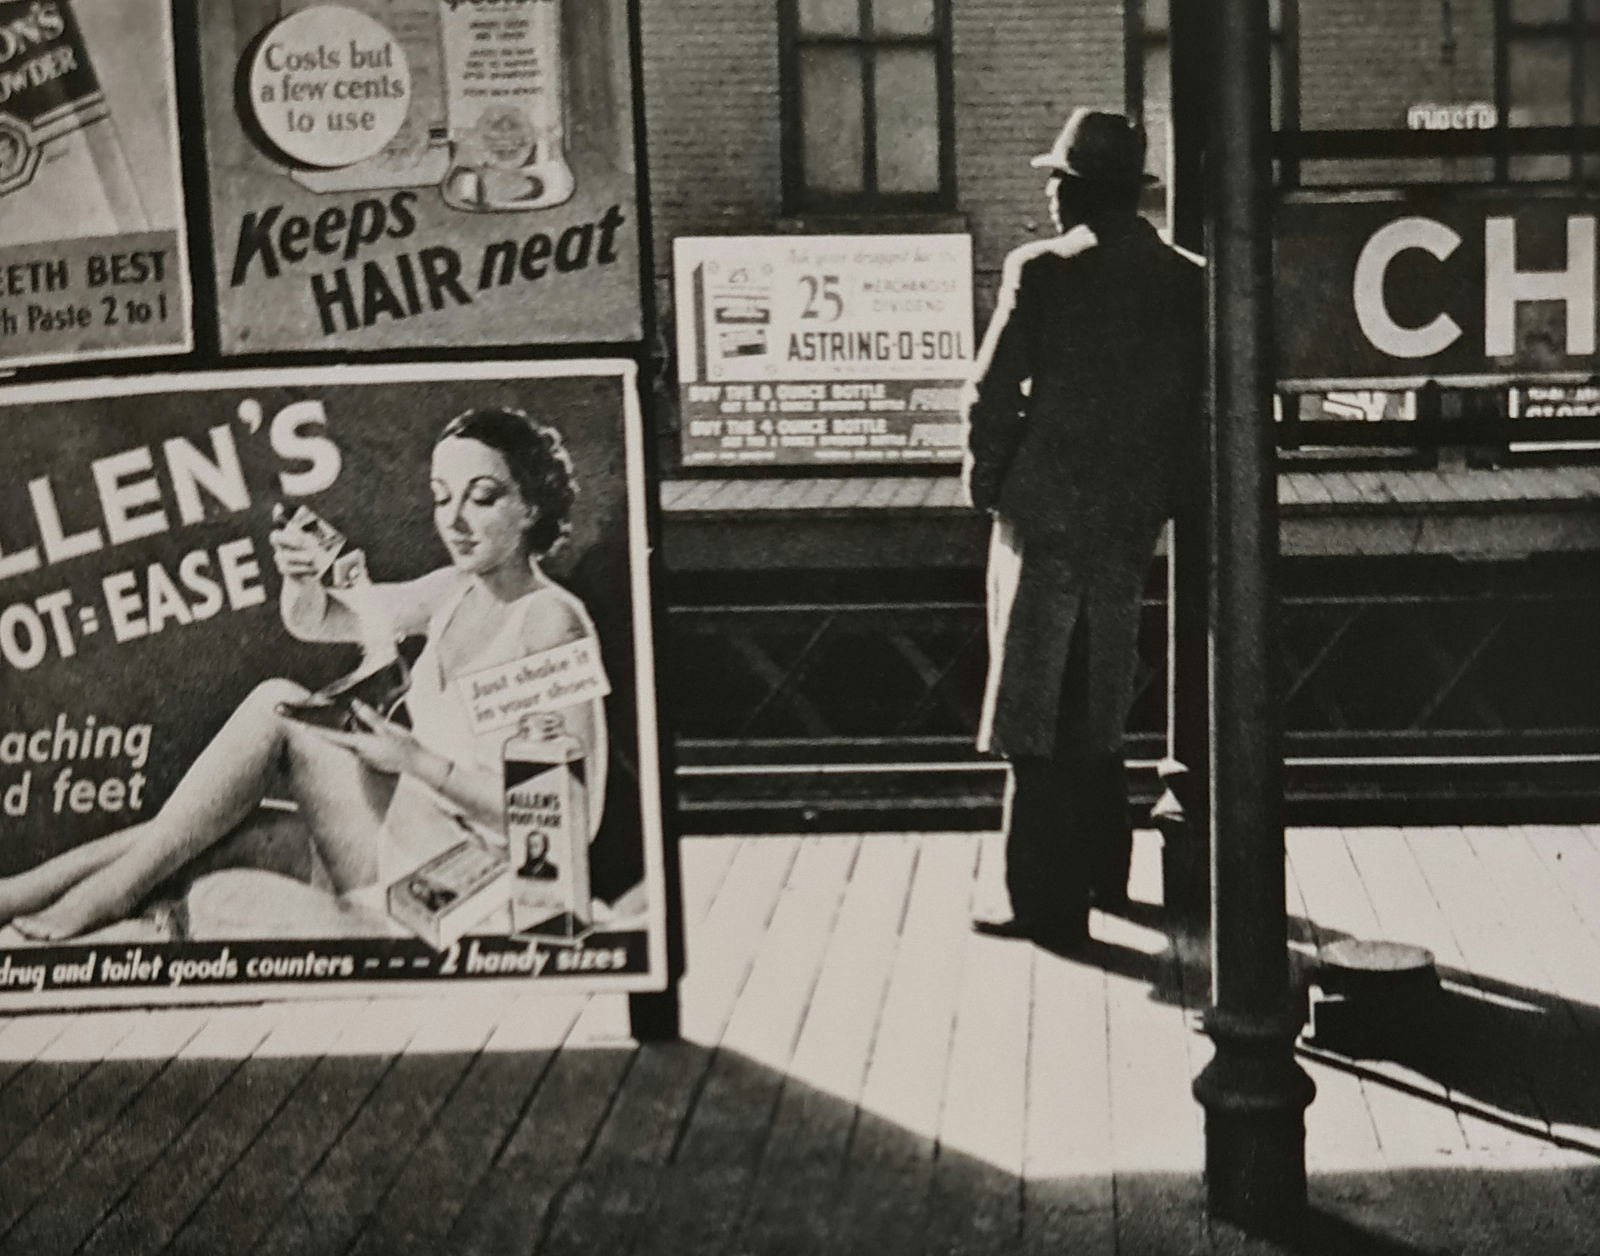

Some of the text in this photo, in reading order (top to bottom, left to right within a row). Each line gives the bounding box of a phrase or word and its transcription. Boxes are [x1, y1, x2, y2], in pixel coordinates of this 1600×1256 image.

[265, 40, 393, 72] Costs but
[260, 75, 405, 103] a few cents
[286, 109, 375, 133] to use
[230, 190, 419, 289] Keeps
[0, 251, 167, 298] ETH BEST
[311, 203, 627, 336] HAIR neat
[1353, 215, 1597, 358] CH
[28, 304, 92, 332] Paste
[101, 296, 119, 327] 2
[126, 304, 152, 325] to
[798, 274, 844, 322] 25
[787, 331, 967, 361] ASTRING-O-SOL
[1, 712, 152, 768] aching
[4, 767, 147, 816] d feet
[0, 940, 627, 992] drug and toilet goods counters 2 handy sizes
